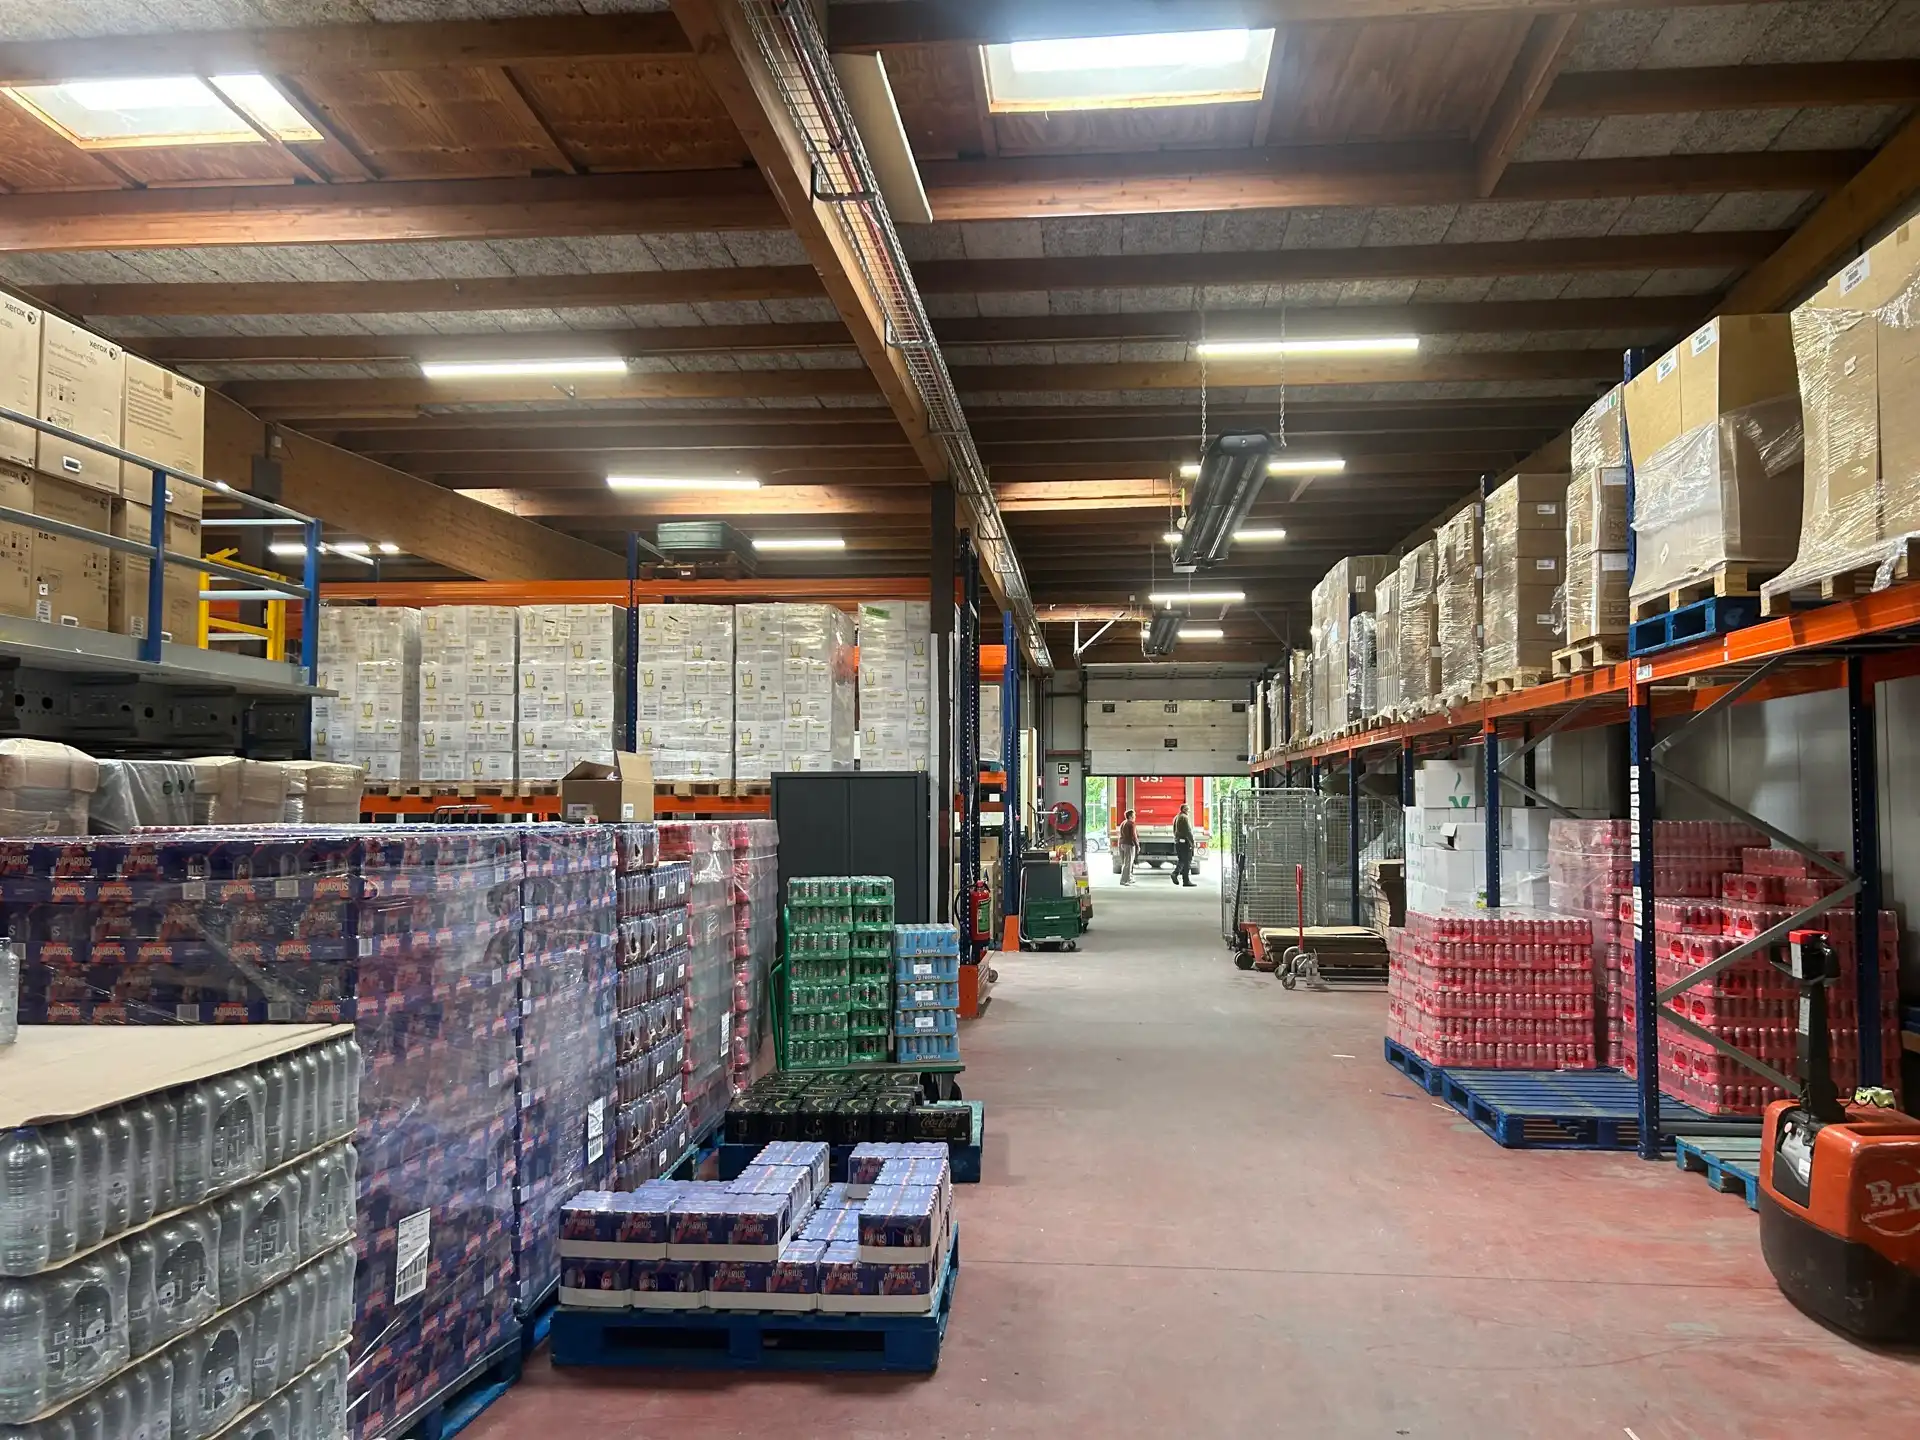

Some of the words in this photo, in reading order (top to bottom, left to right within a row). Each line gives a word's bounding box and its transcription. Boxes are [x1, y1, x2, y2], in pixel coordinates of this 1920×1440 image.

[4, 302, 26, 317] xerox
[89, 340, 108, 354] xerox
[176, 379, 193, 392] xerox
[52, 886, 85, 896] AQUARIUS
[97, 886, 133, 896] AQUARIUS
[220, 885, 256, 895] AQUARIUS
[313, 881, 349, 892] AQUARIUS
[40, 946, 73, 956] AQUARIUS
[91, 946, 126, 956] AQUARIUS
[137, 946, 173, 956] AQUARIUS
[47, 1007, 81, 1017] AQUARIUS
[213, 1007, 248, 1017] AQUARIUS
[305, 1004, 341, 1015] AQUARIUS
